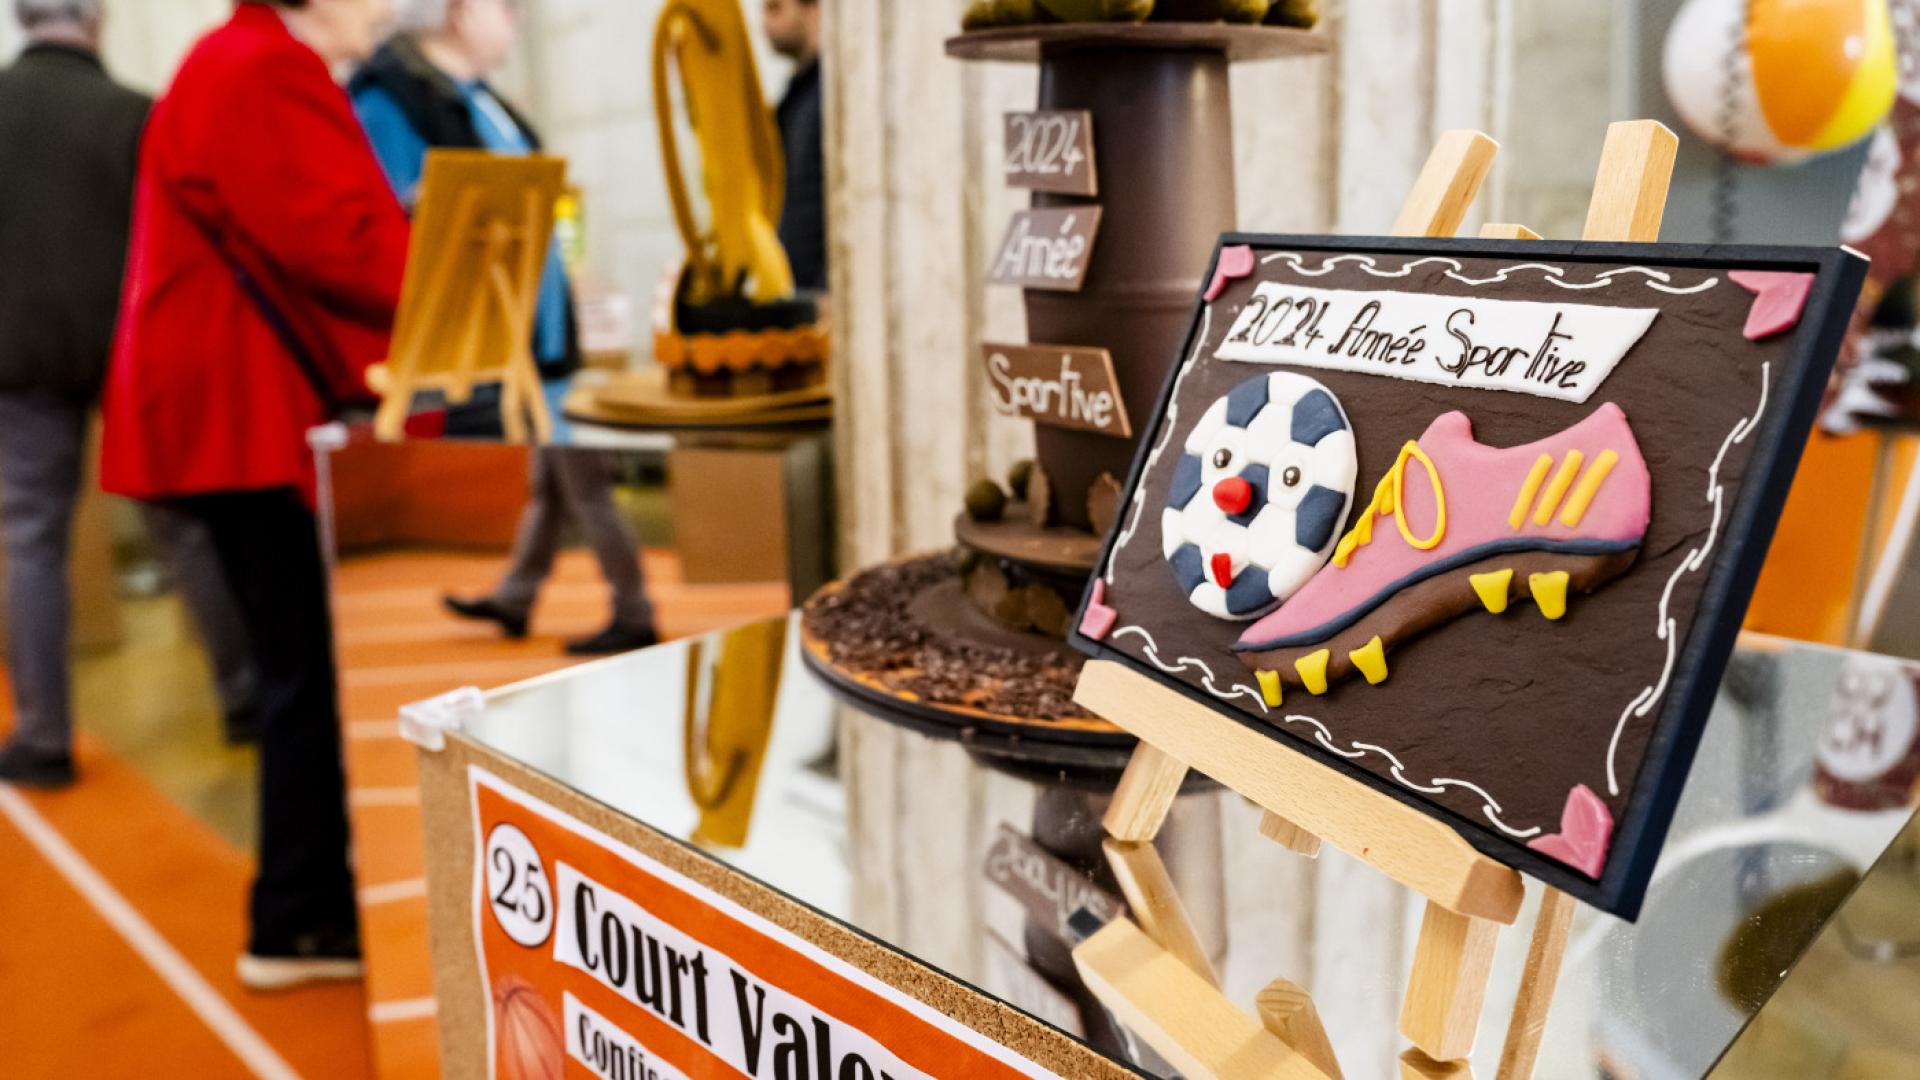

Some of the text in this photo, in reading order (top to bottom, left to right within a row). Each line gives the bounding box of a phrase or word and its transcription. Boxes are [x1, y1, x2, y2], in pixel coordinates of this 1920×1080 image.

[1004, 115, 1084, 175] 2024
[992, 213, 1085, 279] Année
[1229, 295, 1330, 353] 2024
[1435, 308, 1587, 389] Sportive
[988, 352, 1114, 428] Sportive
[493, 847, 545, 923] 25
[574, 881, 895, 1080] Court Val
